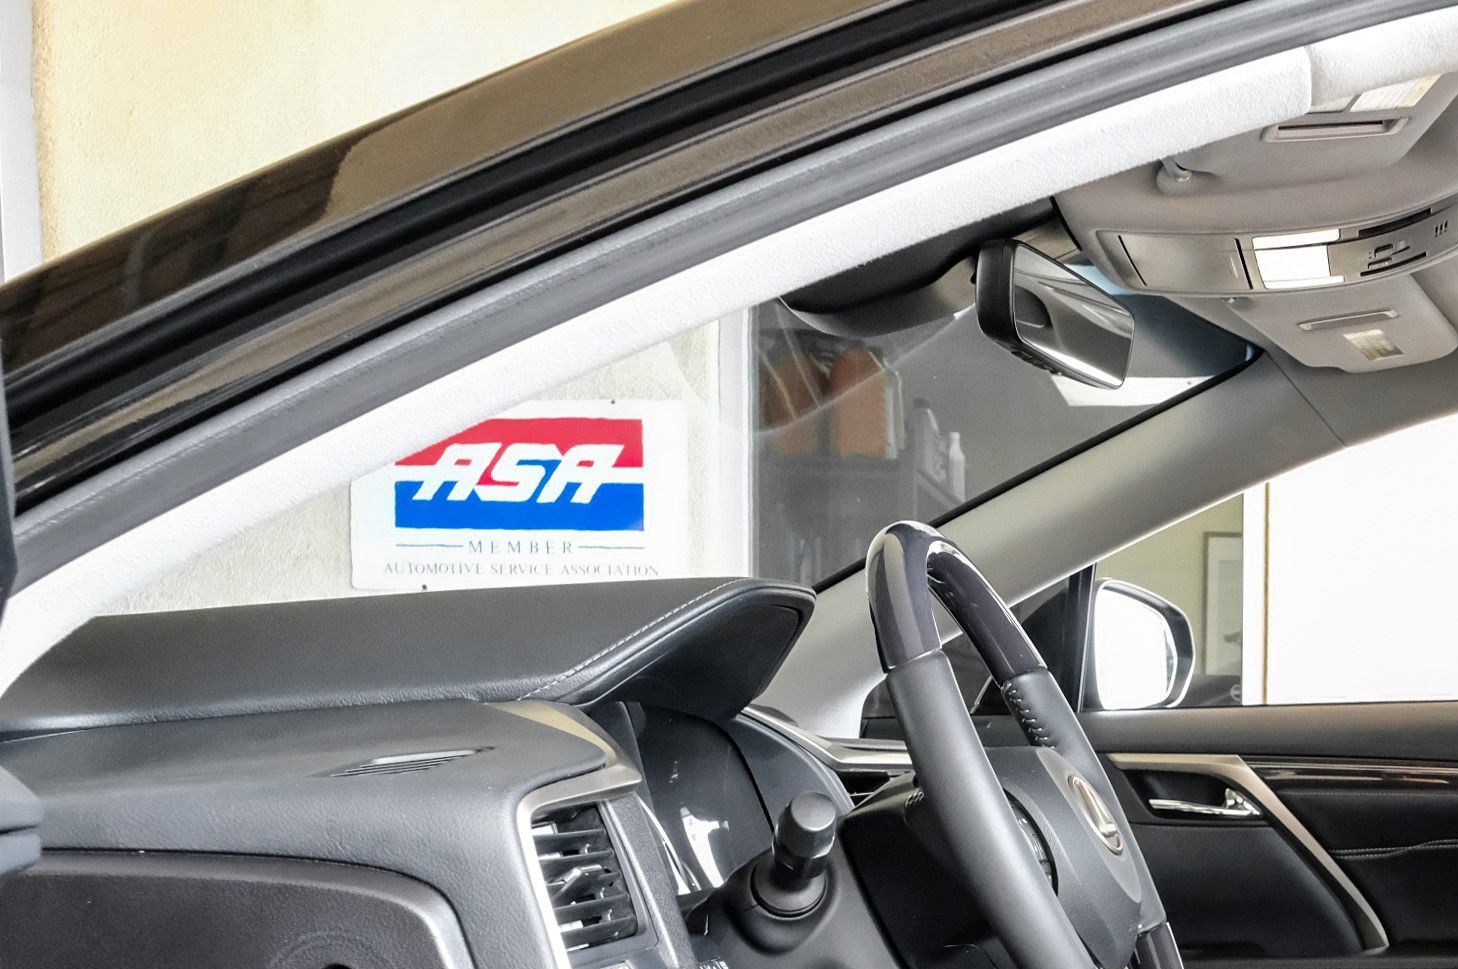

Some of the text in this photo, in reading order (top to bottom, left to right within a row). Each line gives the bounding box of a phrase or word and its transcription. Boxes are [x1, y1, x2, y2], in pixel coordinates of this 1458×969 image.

[411, 442, 628, 504] ASA
[468, 540, 573, 554] MEMBER
[384, 561, 660, 578] AUTOMOTIVE SERVICE ASSOCIATION
